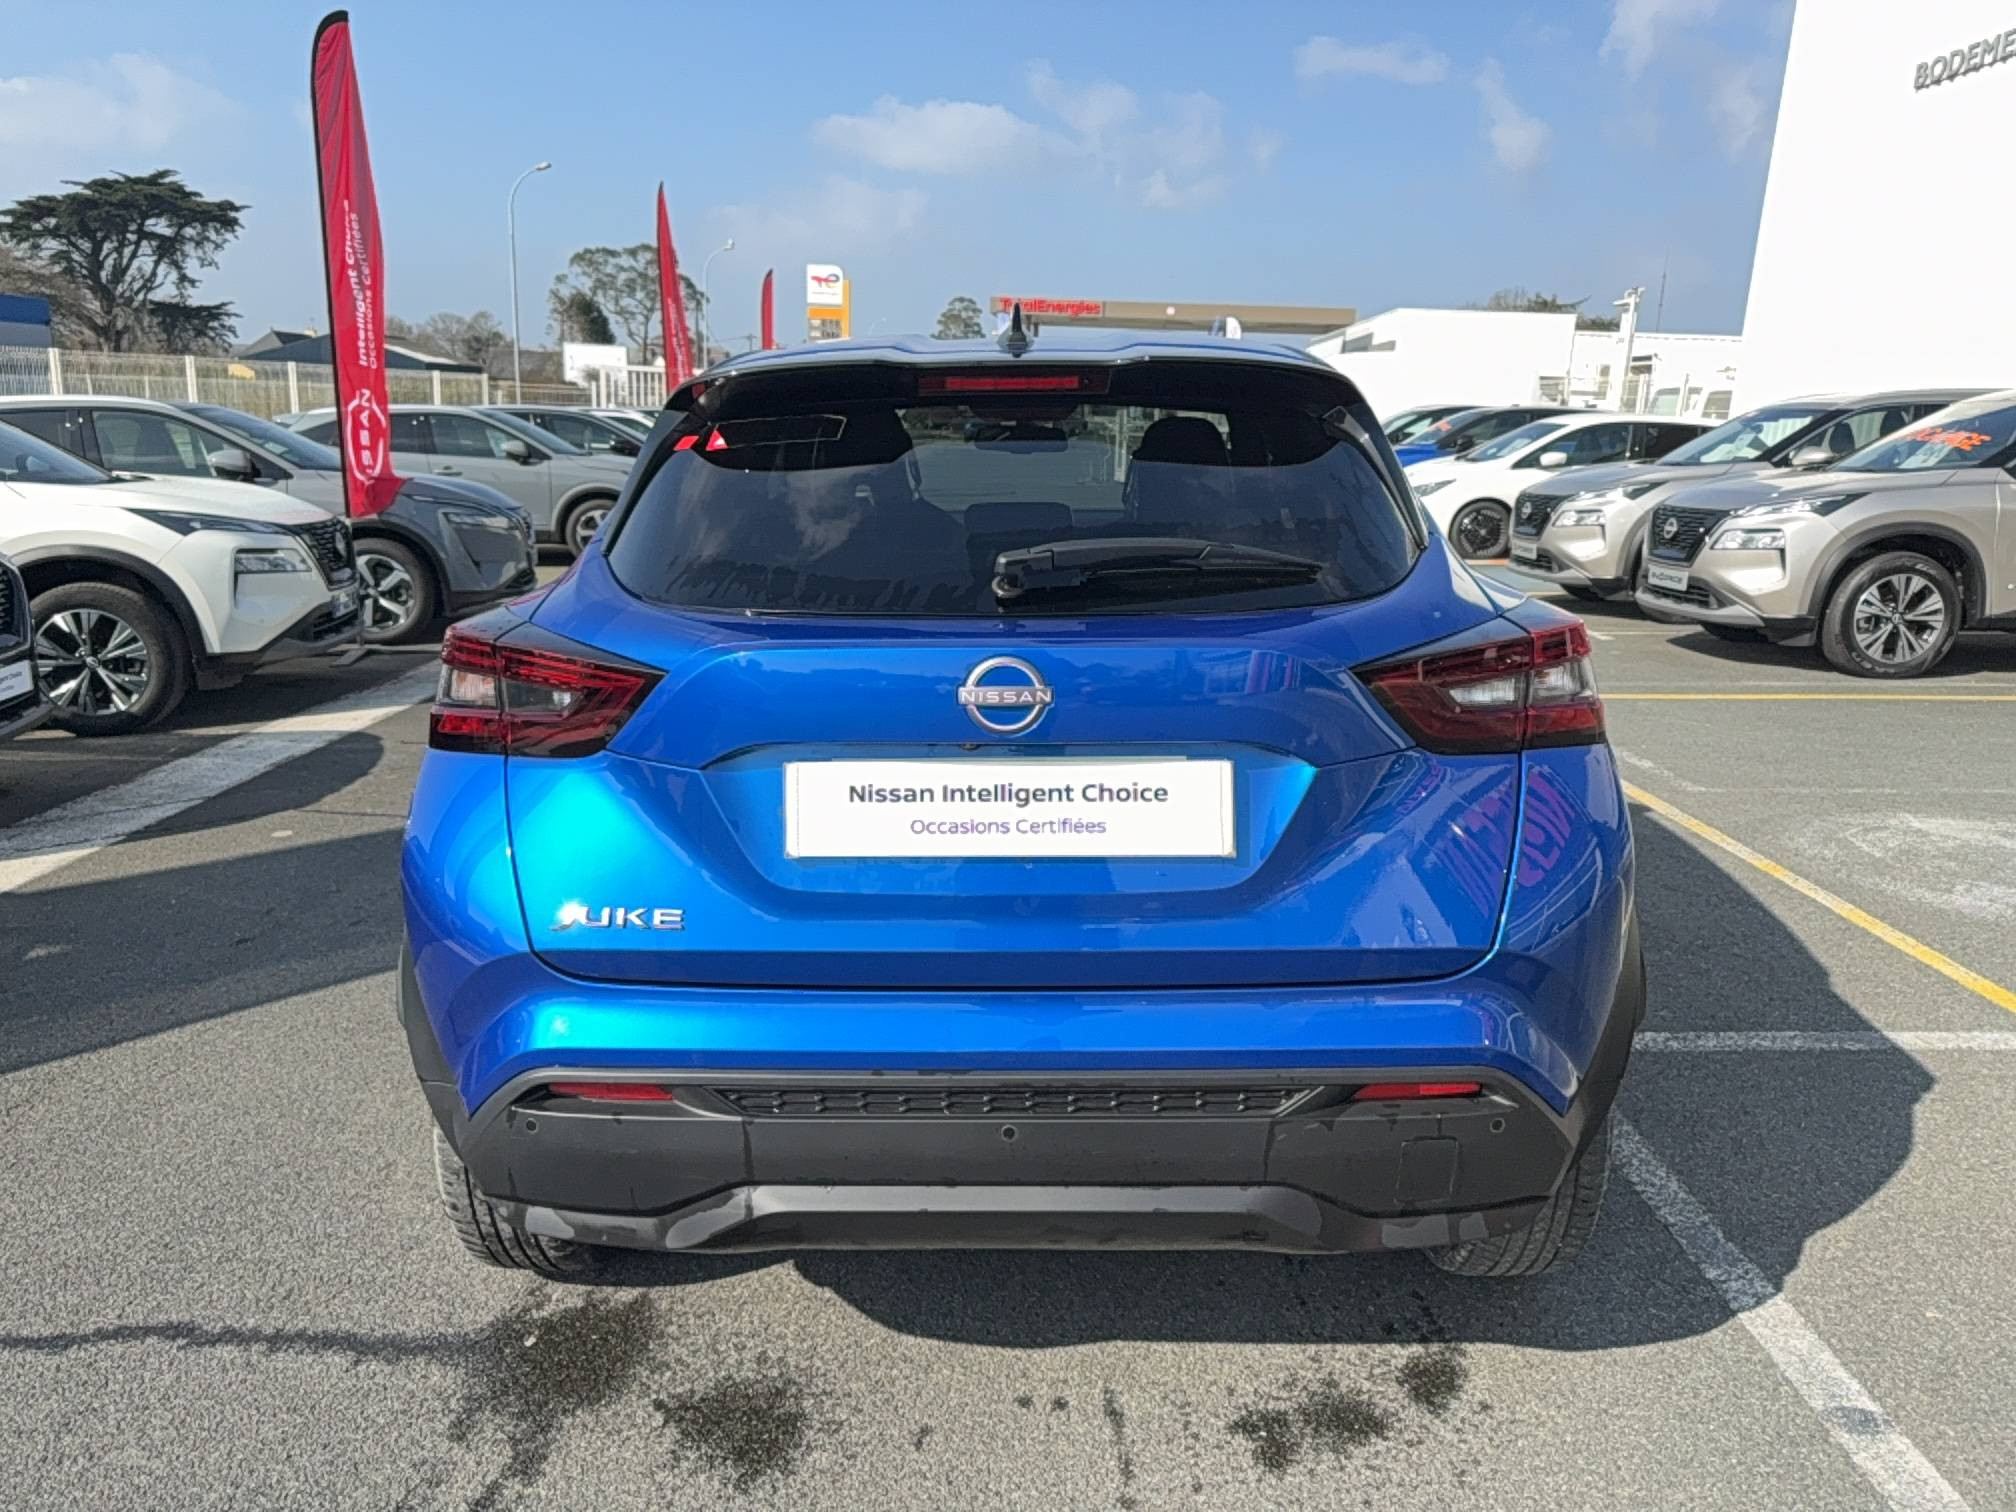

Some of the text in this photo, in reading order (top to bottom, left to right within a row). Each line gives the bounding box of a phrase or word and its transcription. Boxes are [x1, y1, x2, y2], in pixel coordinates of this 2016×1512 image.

[1914, 28, 2016, 91] BODEME
[347, 268, 369, 367] Intelligent
[1000, 297, 1101, 319] TalEnergies
[365, 289, 377, 369] Occasions
[960, 690, 1052, 704] NISSAN
[849, 782, 1169, 808] Nissan Intelligent Choice
[910, 817, 1107, 835] Occasions Certifiées
[550, 905, 686, 931] JUKE
